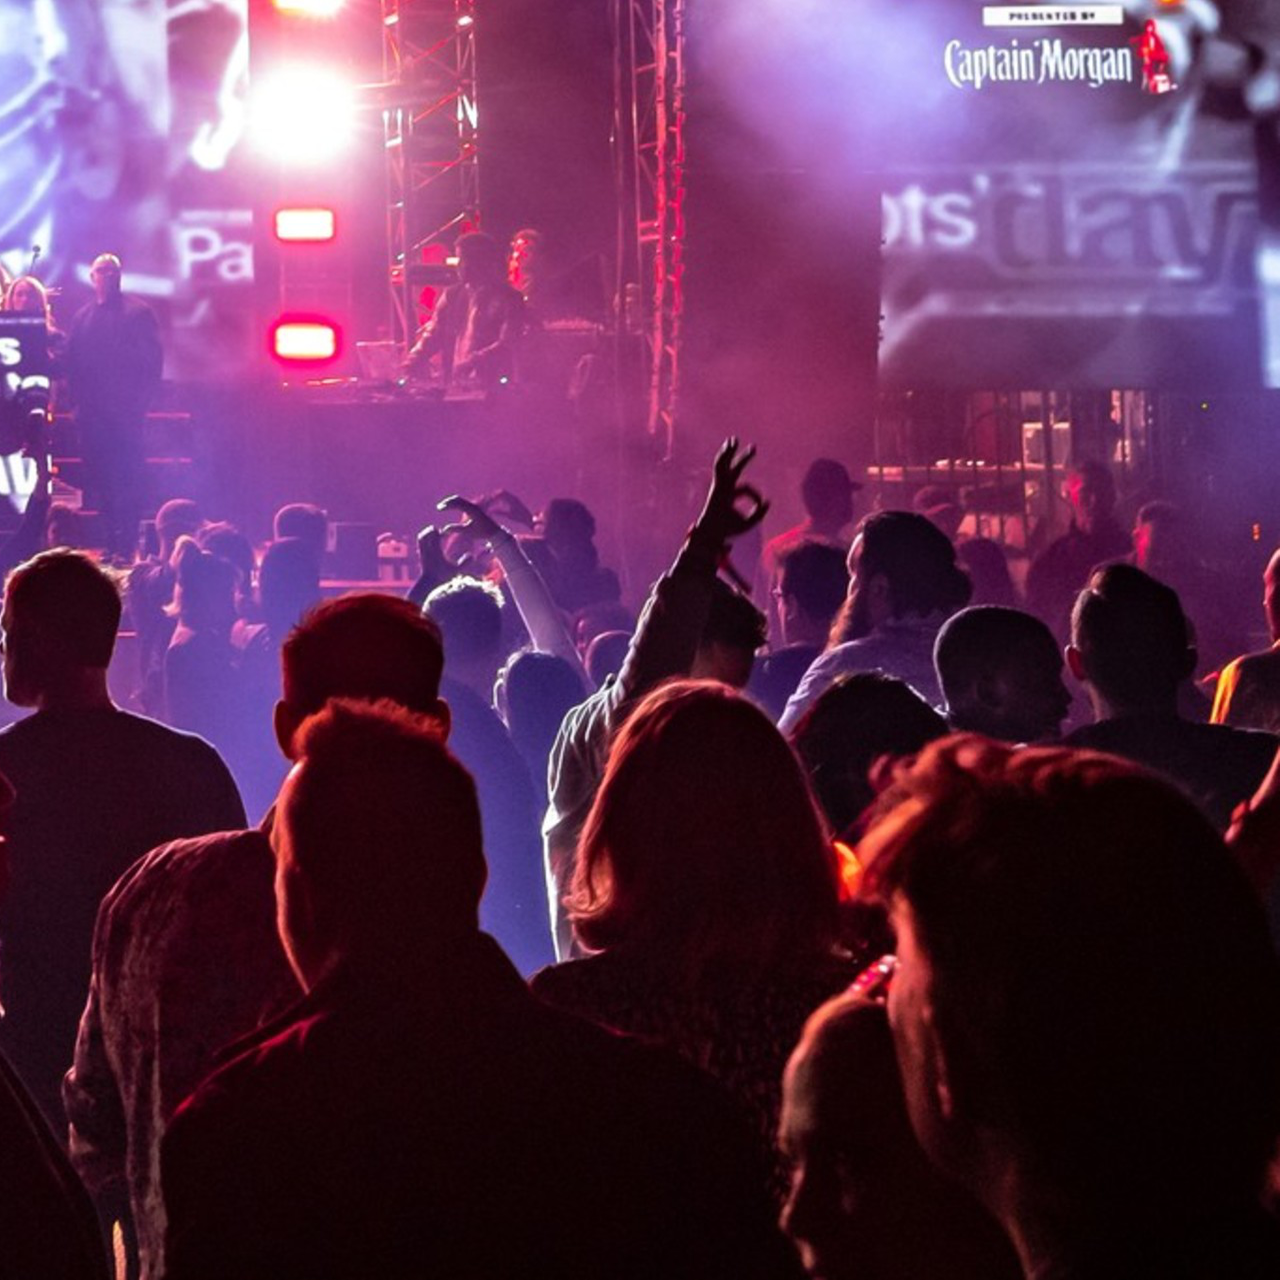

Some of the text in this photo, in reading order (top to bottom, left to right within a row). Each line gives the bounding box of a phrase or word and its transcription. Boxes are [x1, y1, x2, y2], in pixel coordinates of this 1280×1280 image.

[1008, 10, 1096, 21] PRESENTED BY
[944, 39, 1133, 89] Captain Morgan
